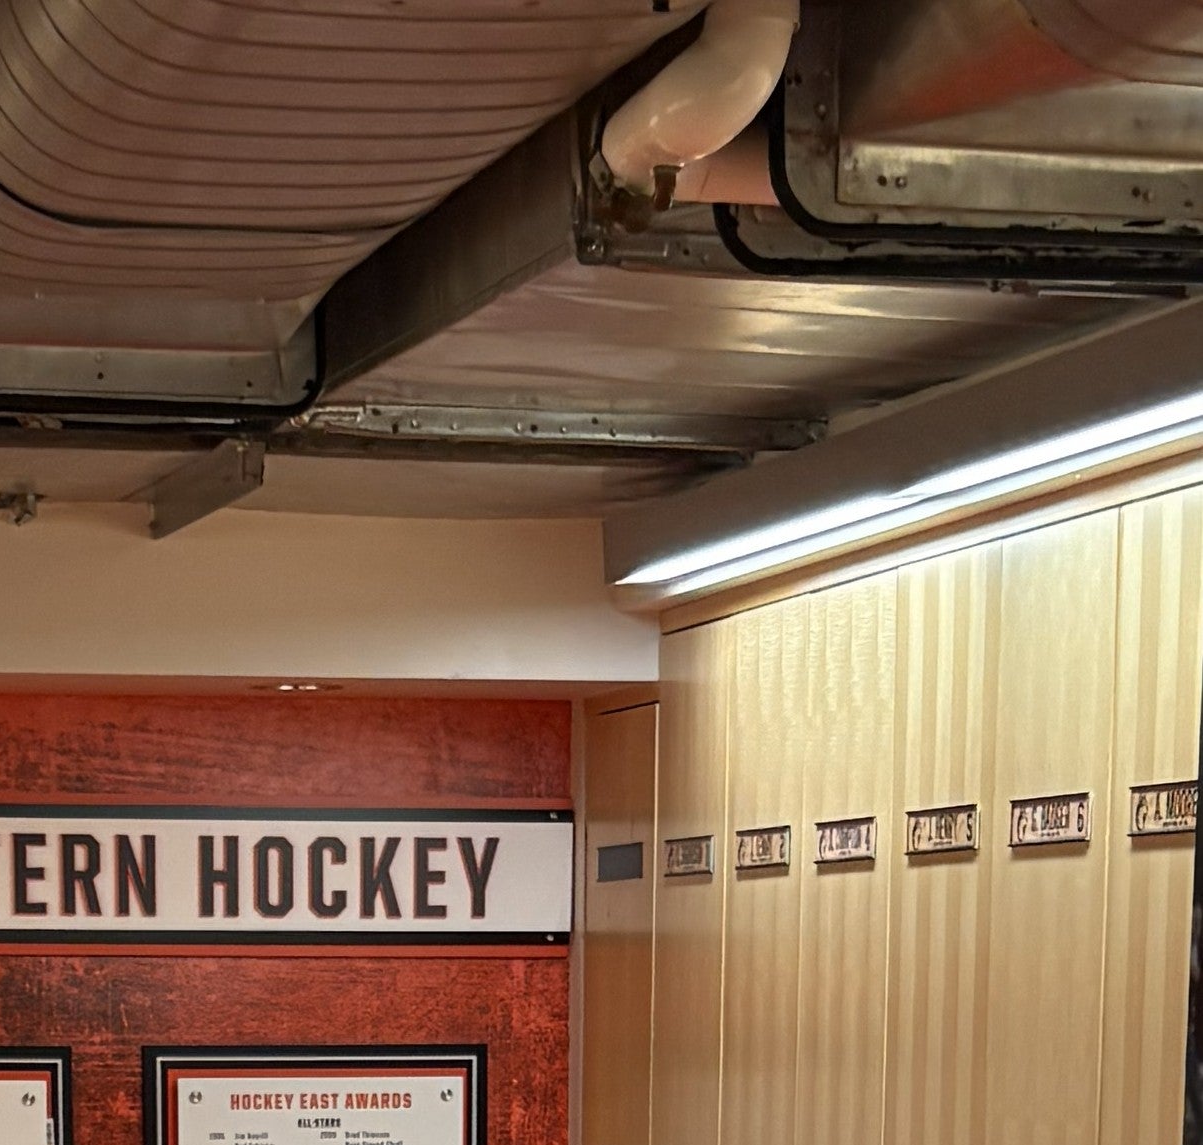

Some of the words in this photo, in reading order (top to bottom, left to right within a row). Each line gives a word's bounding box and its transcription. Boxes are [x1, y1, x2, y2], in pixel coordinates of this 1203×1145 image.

[198, 834, 500, 920] HOCKEY
[230, 1093, 294, 1110] HOCKEY
[299, 1093, 338, 1109] EAST
[344, 1092, 412, 1109] AWARDS
